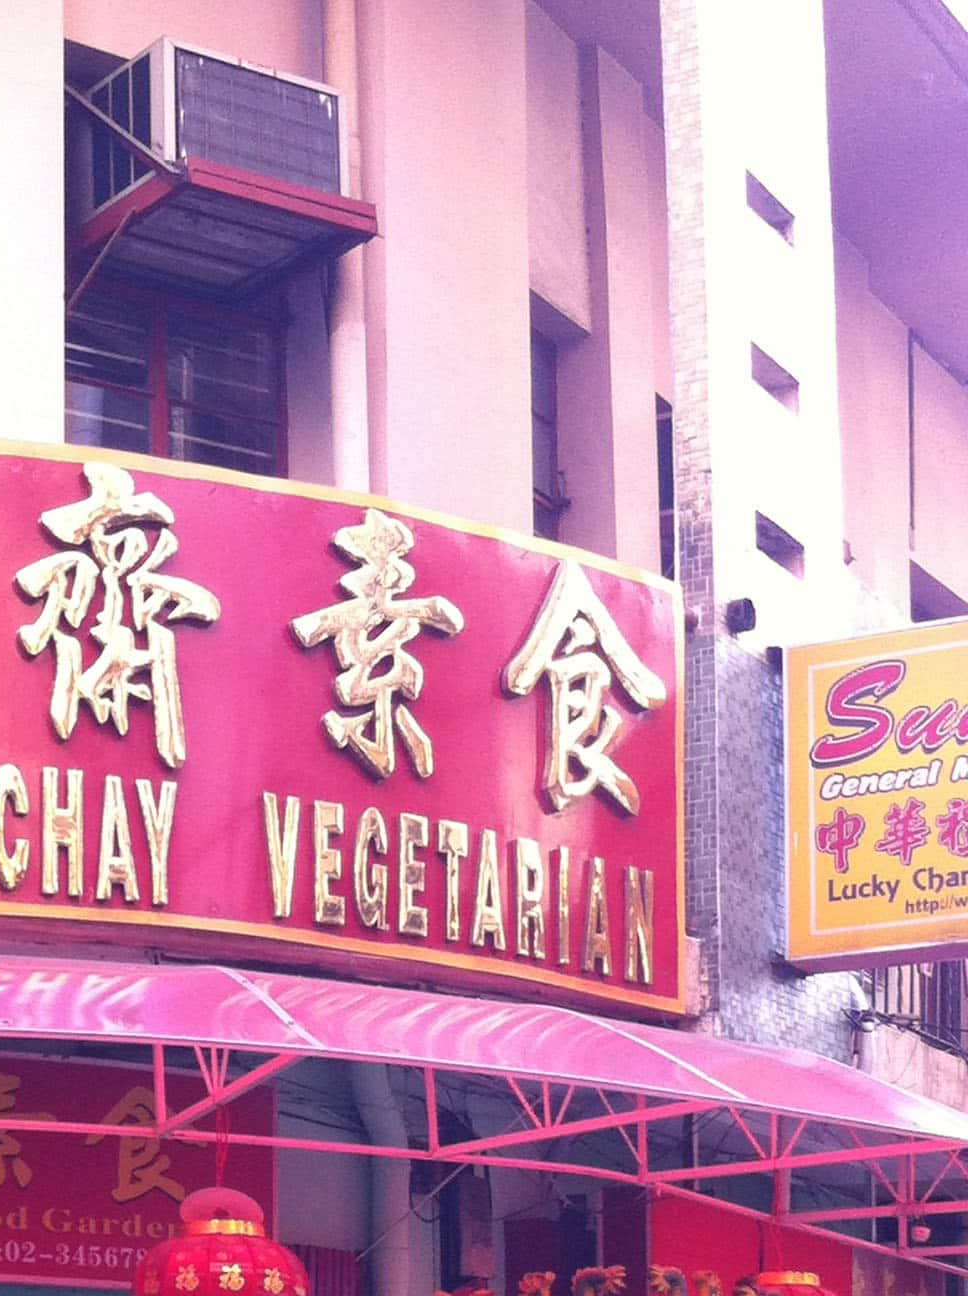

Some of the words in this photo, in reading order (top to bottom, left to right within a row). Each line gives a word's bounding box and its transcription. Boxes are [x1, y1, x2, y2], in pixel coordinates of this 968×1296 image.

[809, 659, 968, 769] Su
[820, 759, 943, 800] General
[263, 791, 655, 985] VEGETARIAN
[828, 874, 900, 902] Lucky
